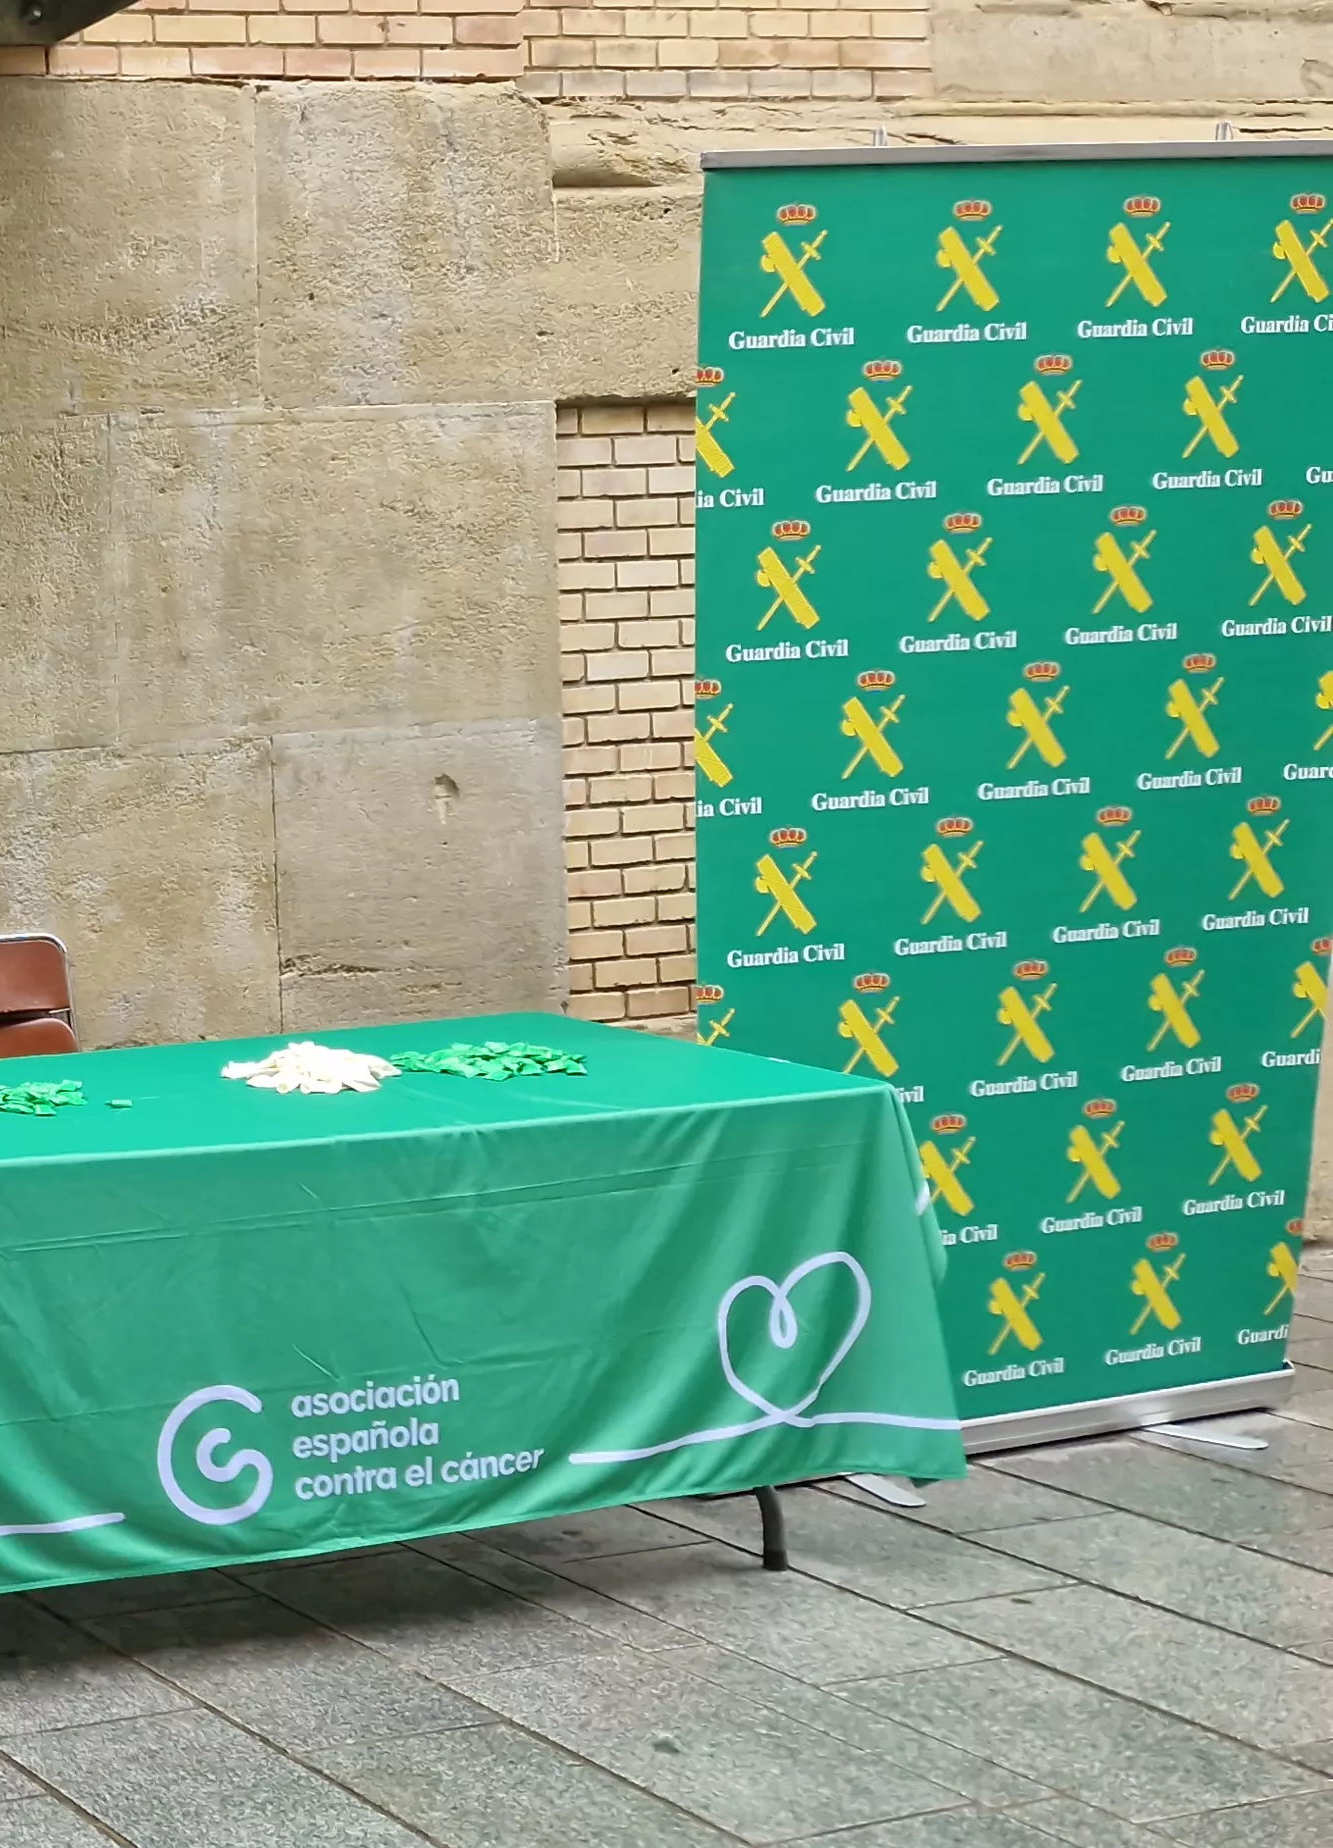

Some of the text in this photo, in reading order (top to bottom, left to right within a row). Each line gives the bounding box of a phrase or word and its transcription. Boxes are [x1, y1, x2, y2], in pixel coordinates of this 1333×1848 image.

[905, 321, 1028, 344] Guardia Civil
[1076, 317, 1194, 339] Guardia Civil
[1240, 314, 1310, 334] Guardia
[728, 327, 855, 350] Guardia Civil
[986, 474, 1104, 497] Guardia Civil
[1151, 468, 1263, 490] Guardia Civil
[719, 487, 765, 508] Civil
[814, 480, 937, 504] Guardia Civil
[1064, 622, 1178, 646] Guardia Civil
[1220, 615, 1333, 638] Guardia Civil
[725, 638, 849, 663] Guardia Civil
[898, 630, 1018, 654] Guardia Civil
[976, 776, 1091, 801] Guardia Civil
[1136, 766, 1243, 791] Guardia Civil
[718, 796, 763, 817] Civil
[810, 786, 930, 811] Guardia Civil
[1051, 918, 1161, 944] Guardia Civil
[1201, 906, 1310, 931] Guardia Civil
[726, 942, 846, 968] Guardia Civil
[893, 931, 1008, 956] Guardia Civil
[1120, 1055, 1222, 1082] Guardia Civil
[968, 1070, 1078, 1098] Guardia Civil
[1182, 1189, 1286, 1216] Guardia Civil
[1039, 1205, 1143, 1234] Guardia Civil
[958, 1223, 998, 1244] Civil
[1104, 1336, 1202, 1366] Guardia Civil
[962, 1357, 1065, 1387] Guardia Civil
[290, 1373, 460, 1418] asociación
[292, 1416, 440, 1464] española
[294, 1448, 545, 1501] contra el cáncer
